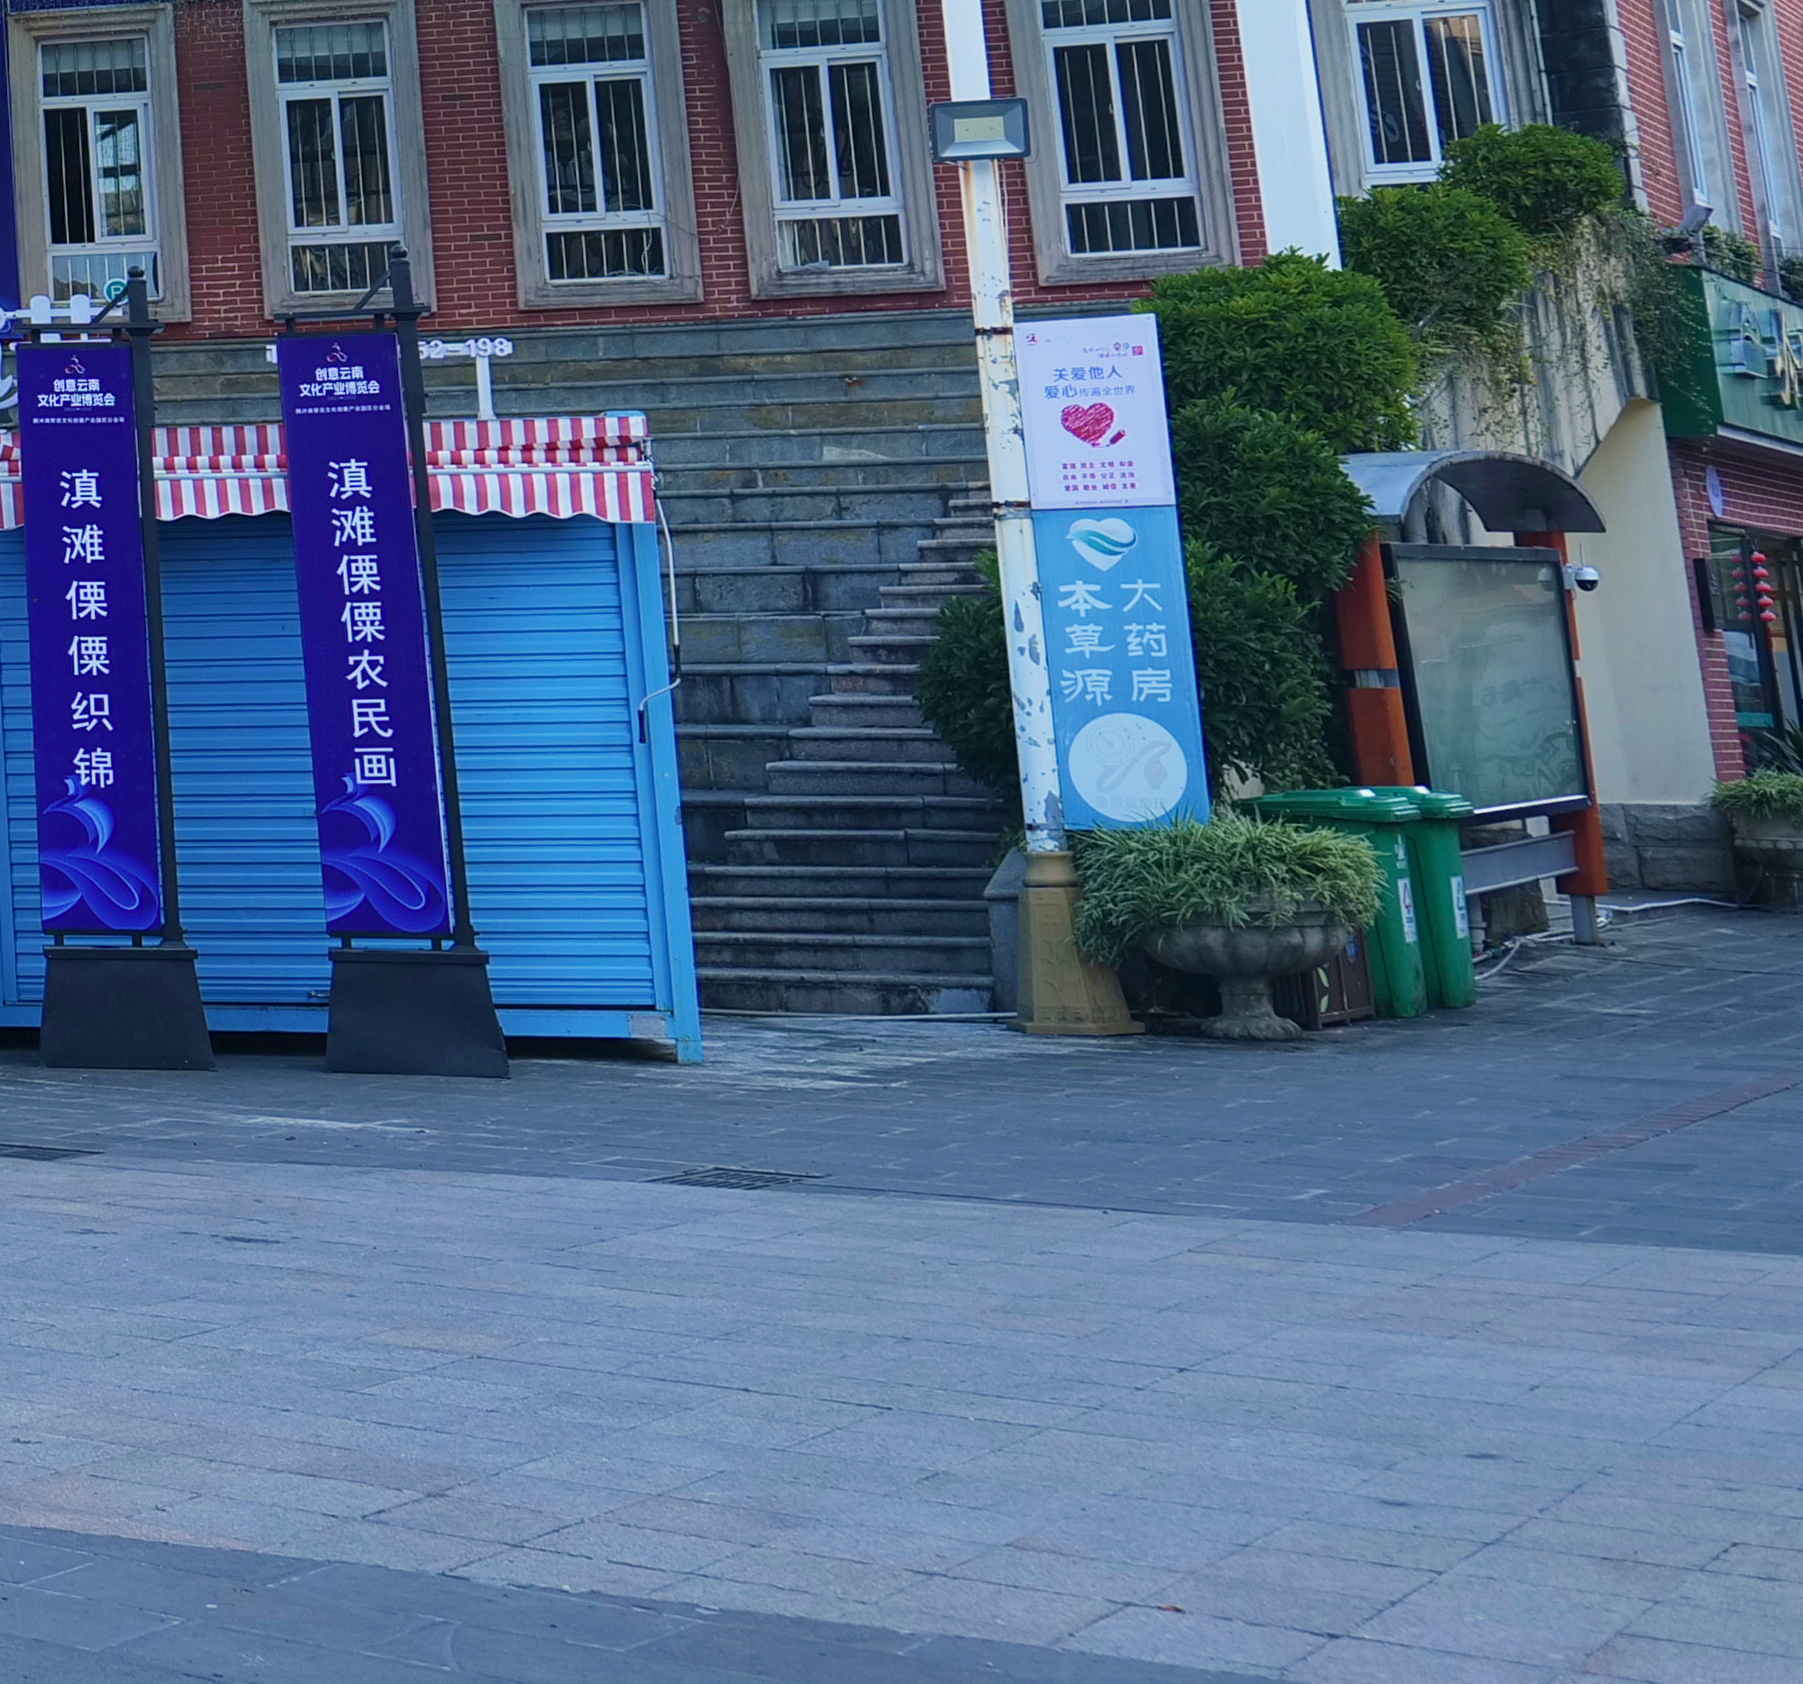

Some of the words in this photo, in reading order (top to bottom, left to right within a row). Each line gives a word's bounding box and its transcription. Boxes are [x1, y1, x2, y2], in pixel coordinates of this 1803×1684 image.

[315, 366, 364, 381] 创意云南
[1053, 365, 1123, 382] 关爱他人
[53, 379, 100, 392] 创意云南
[299, 380, 380, 396] 文化产业博览会
[1044, 384, 1135, 399] 爱心传遍全世界
[37, 393, 116, 406] 文化产业博览会
[59, 470, 115, 788] 滇滩傈僳织锦
[327, 459, 397, 787] 滇滩傈僳农民画
[1057, 580, 1116, 706] 本草源
[1120, 578, 1174, 703] 大药房
